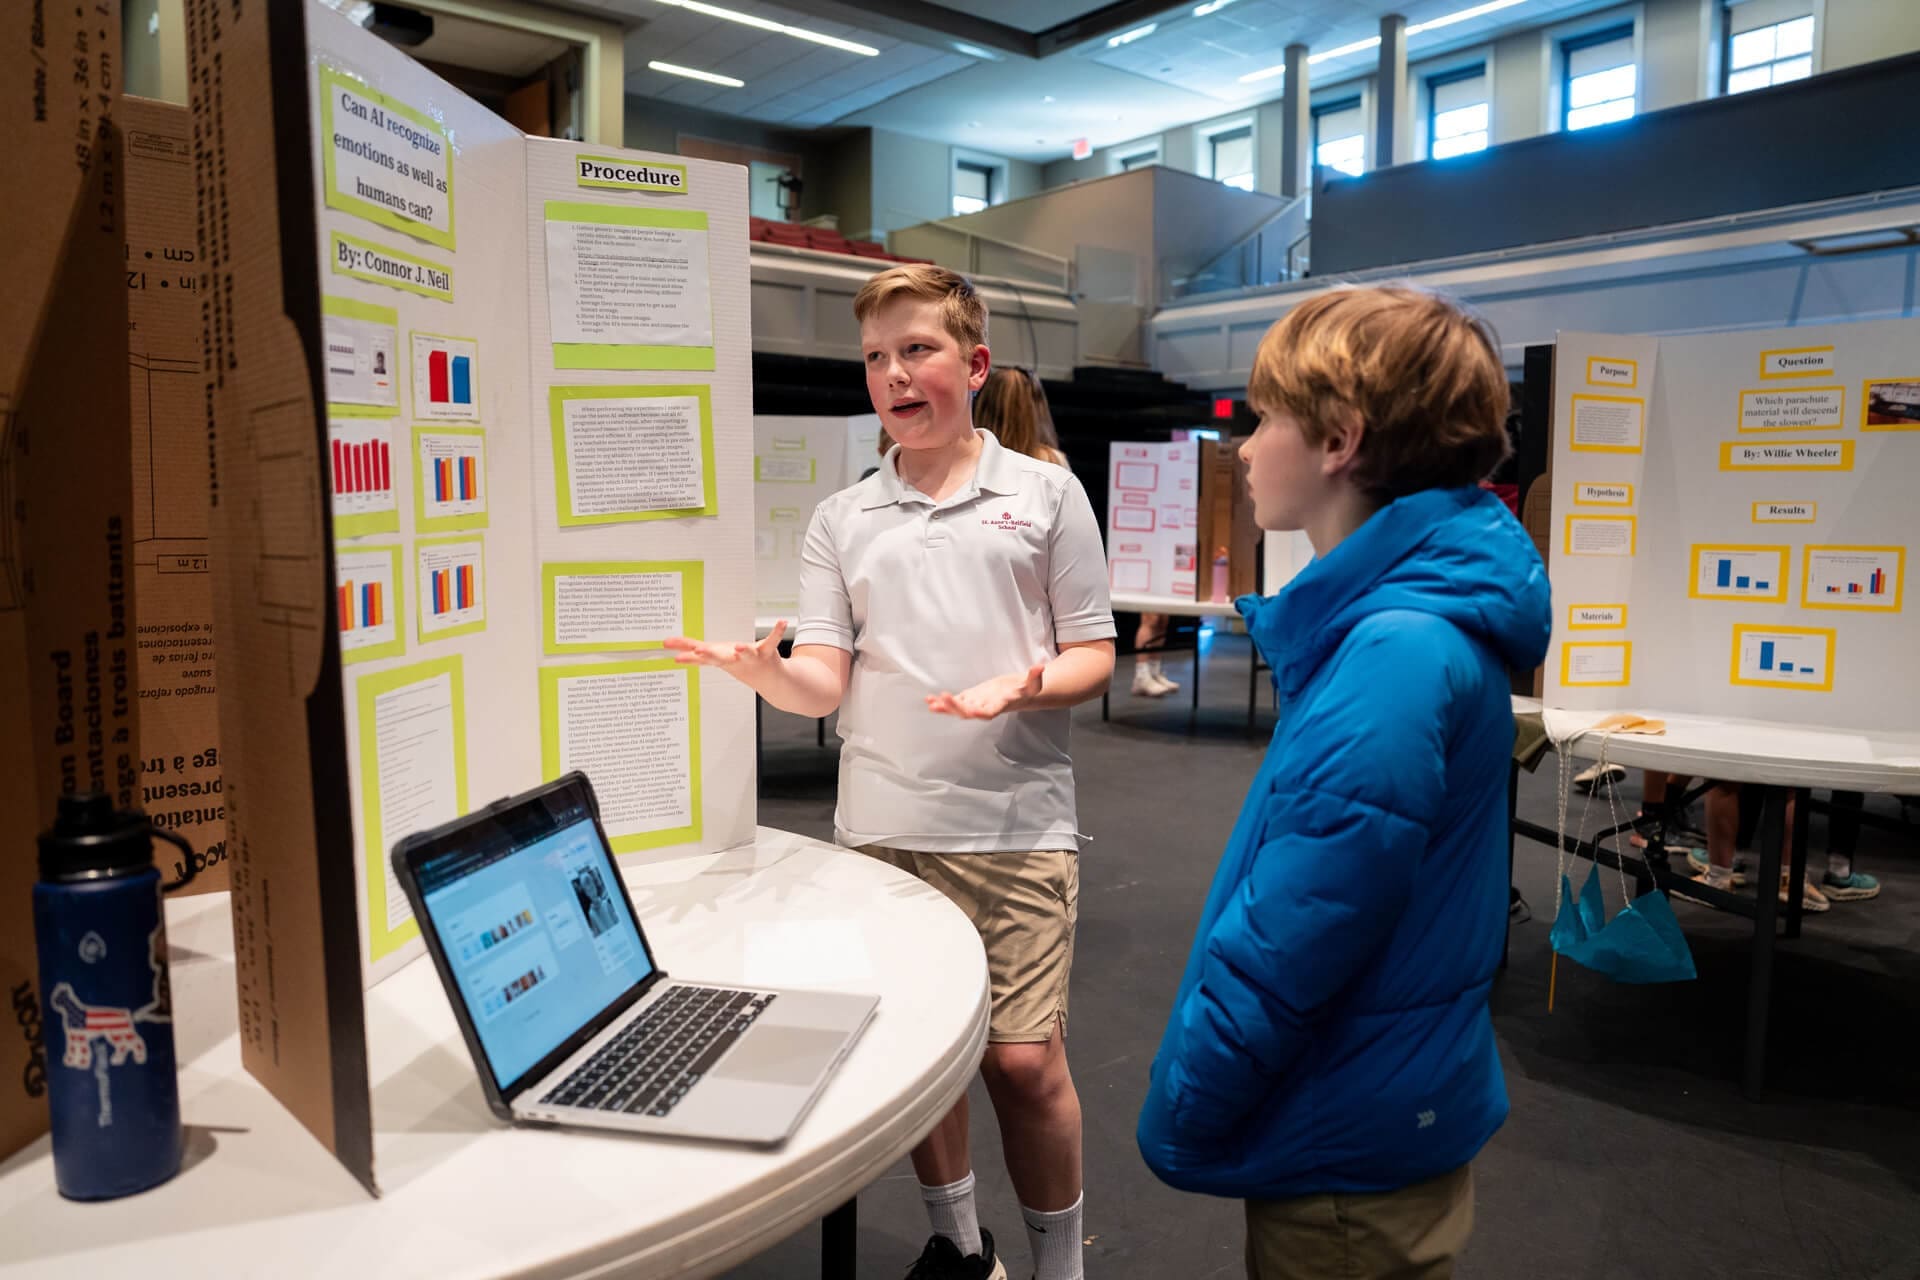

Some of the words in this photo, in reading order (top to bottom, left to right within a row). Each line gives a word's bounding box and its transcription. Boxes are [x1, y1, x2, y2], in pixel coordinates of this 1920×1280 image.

[74, 29, 88, 54] in
[74, 58, 88, 88] 36
[98, 52, 110, 90] cm
[342, 93, 367, 120] Can
[370, 108, 384, 128] AI
[386, 116, 440, 155] recognize
[334, 132, 400, 170] emotions
[397, 159, 409, 176] as
[412, 163, 434, 188] well
[436, 176, 448, 193] as
[580, 161, 680, 186] Procedure
[357, 176, 406, 212] humans
[408, 199, 433, 221] can?
[164, 248, 194, 263] cm
[338, 240, 362, 269] By:
[365, 251, 412, 281] Connor
[415, 266, 425, 284] J.
[428, 270, 450, 291] Neil
[179, 276, 197, 294] in
[1778, 356, 1824, 368] Question
[1600, 366, 1628, 377] Purpose
[1755, 397, 1783, 405] Which
[1786, 395, 1829, 406] parachute
[1745, 408, 1780, 416] material
[1782, 408, 1799, 416] will
[1801, 406, 1838, 415] descend
[1763, 419, 1776, 427] the
[1744, 450, 1760, 460] By:
[1763, 449, 1792, 458] Willie
[1796, 449, 1838, 457] Wheeler
[1587, 488, 1624, 498] Hypothesis
[1770, 506, 1805, 514] Results
[178, 559, 190, 567] m
[1581, 612, 1613, 620] Materials
[152, 655, 166, 664] de
[169, 651, 198, 663] ferias
[182, 669, 212, 679] suave
[50, 650, 74, 745] Board
[173, 756, 185, 774] à
